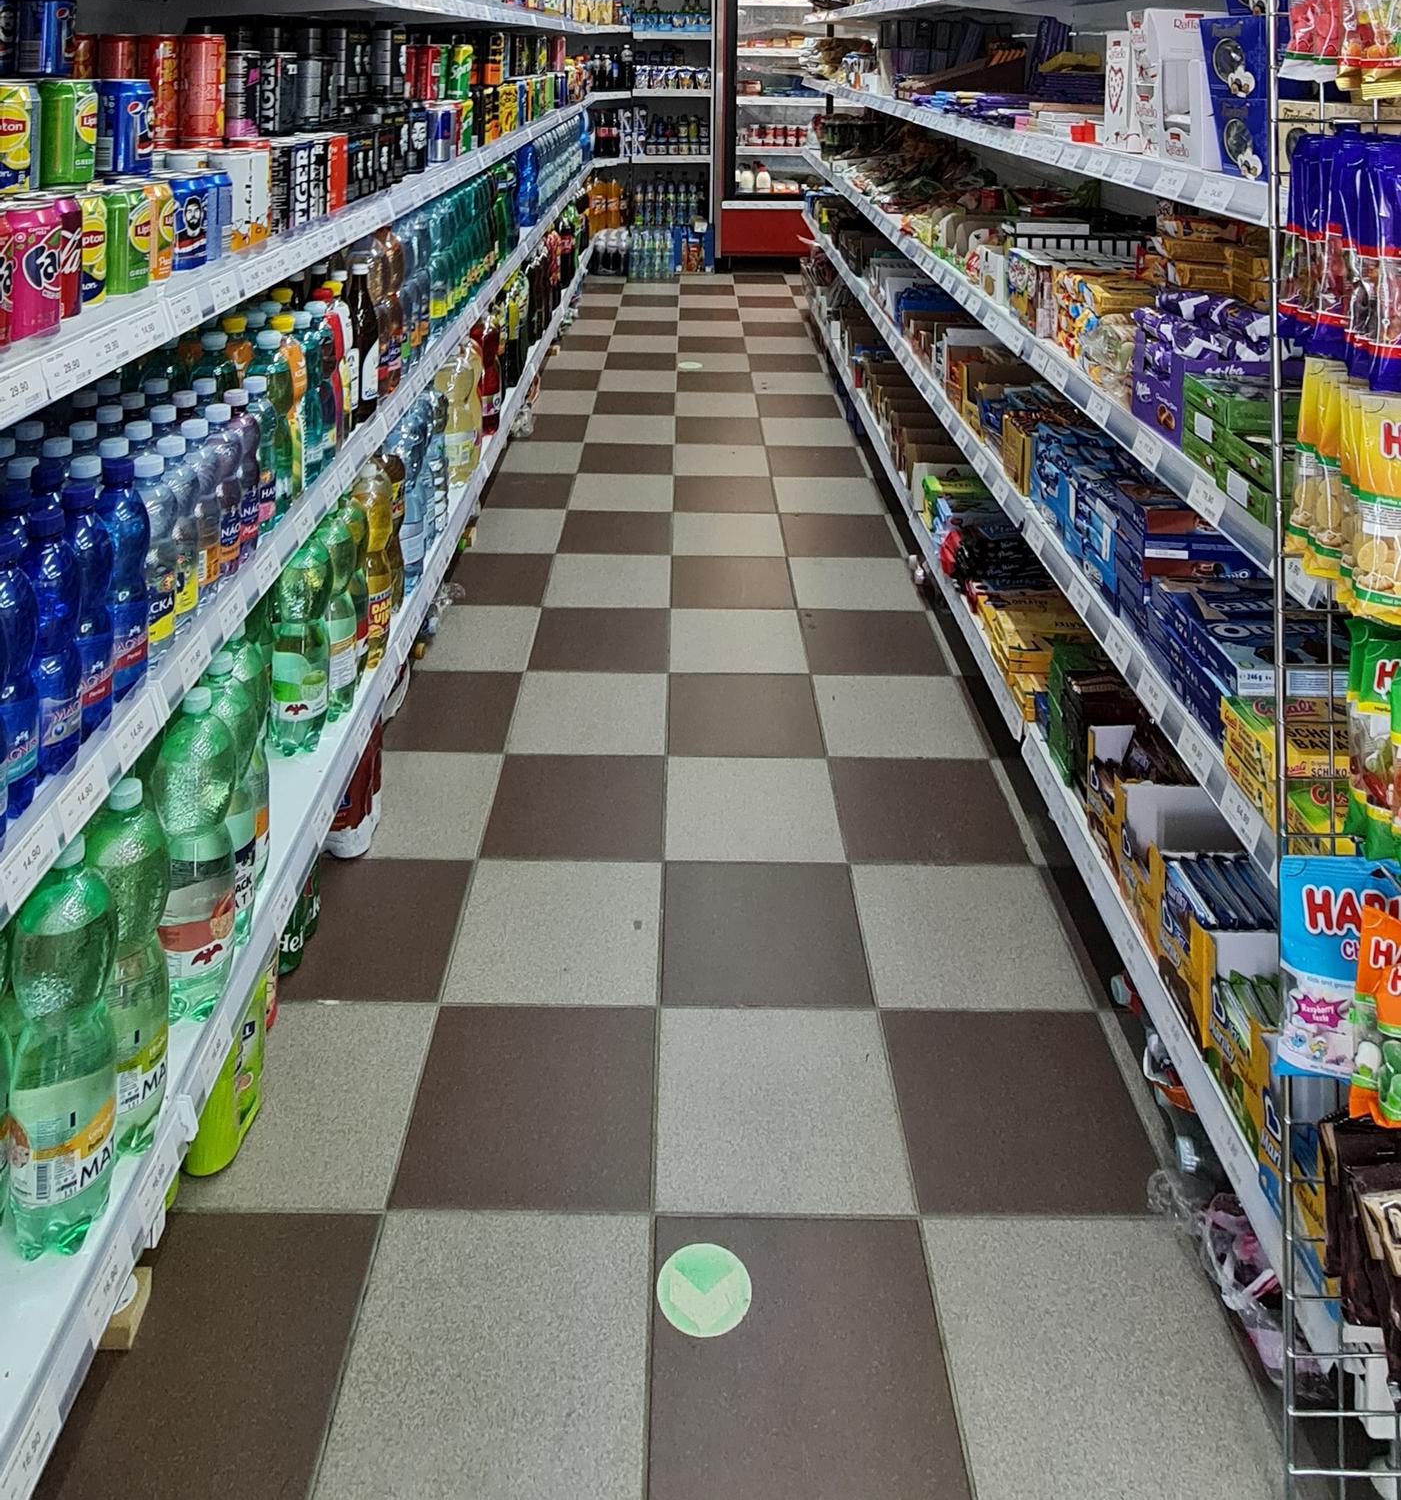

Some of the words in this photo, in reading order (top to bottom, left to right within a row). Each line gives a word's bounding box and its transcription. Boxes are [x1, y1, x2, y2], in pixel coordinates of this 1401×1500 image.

[9, 380, 29, 398] 29.90
[77, 782, 94, 806] 14.90
[22, 844, 42, 872] 14.90
[1301, 1002, 1335, 1014] Raspberry
